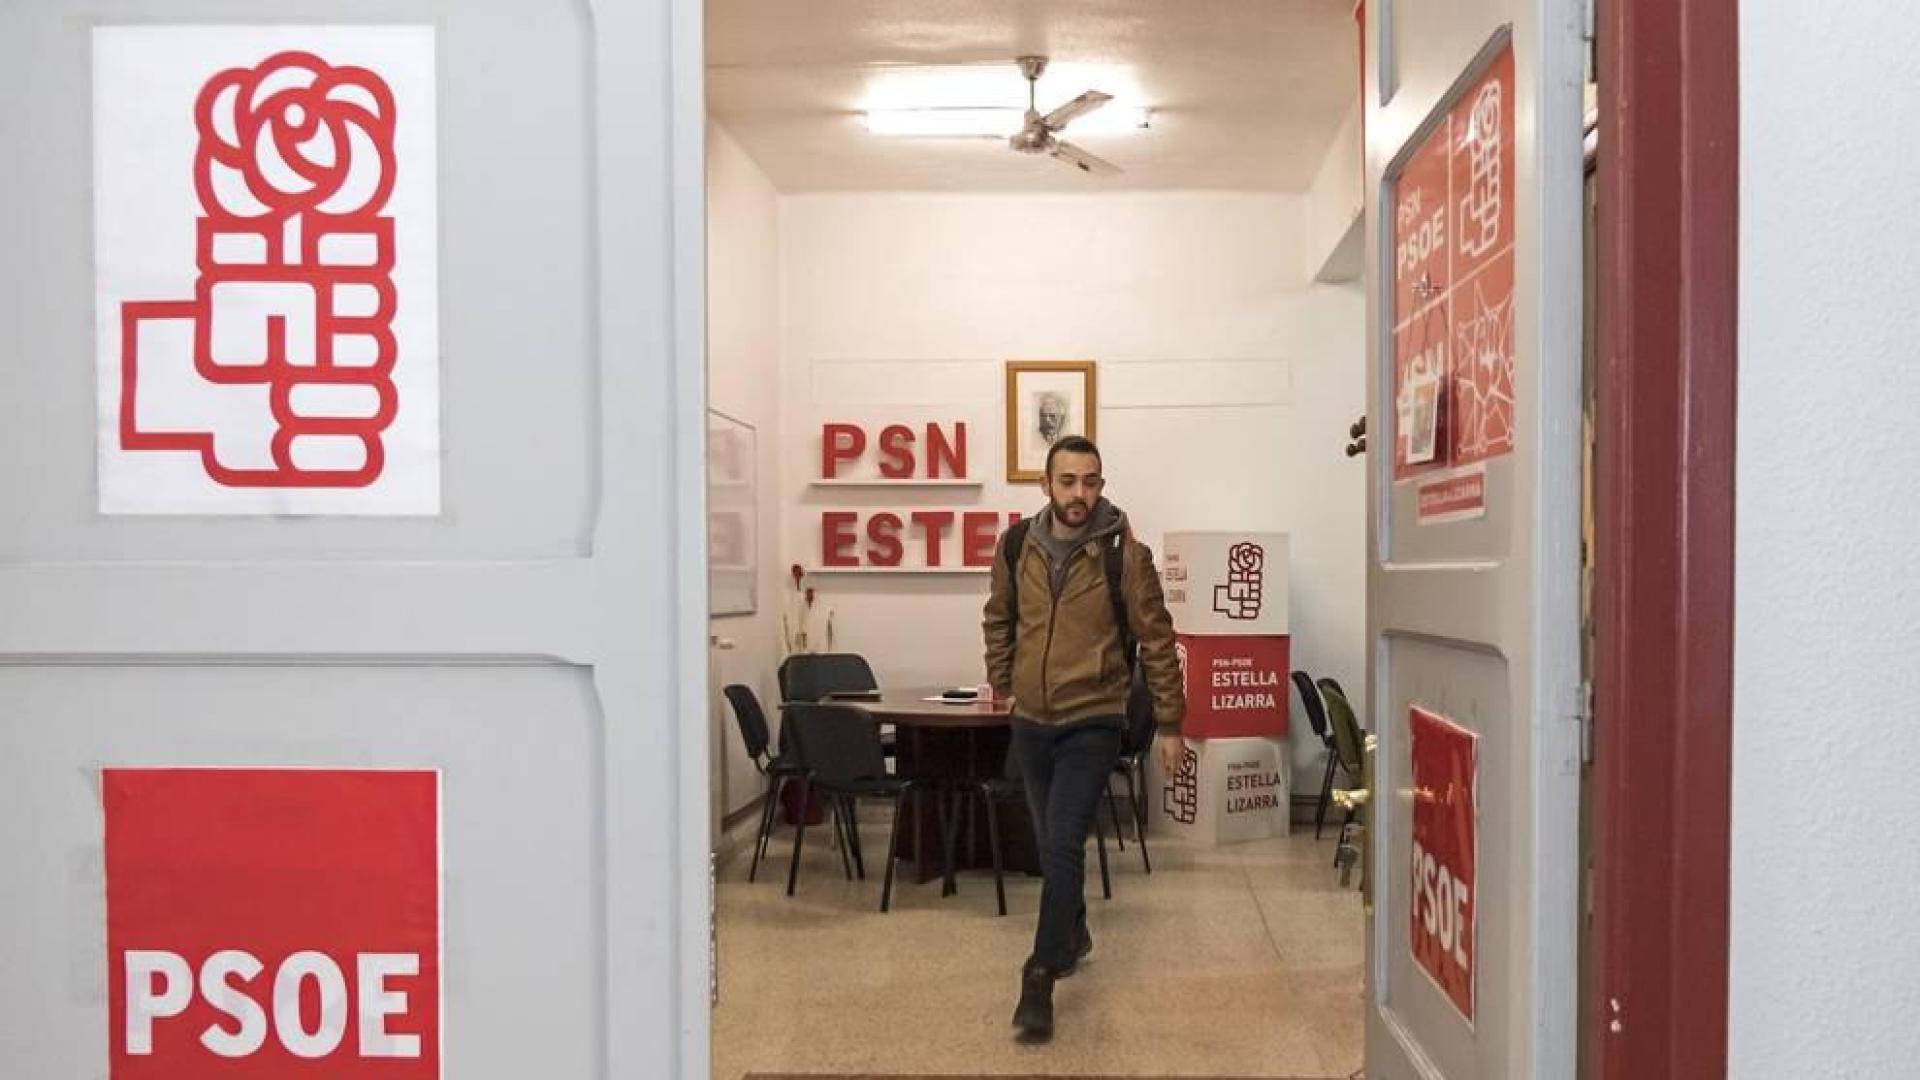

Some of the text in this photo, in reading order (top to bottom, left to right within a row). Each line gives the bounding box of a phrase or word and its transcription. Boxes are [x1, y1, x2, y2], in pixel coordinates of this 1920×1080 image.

[1398, 206, 1444, 281] PSOE
[823, 422, 966, 479] PSN
[822, 511, 1022, 567] ESTE
[1212, 671, 1277, 687] ESTELLA
[1212, 694, 1275, 710] LIZARRA
[1227, 772, 1280, 791] ESTELLA
[1227, 795, 1278, 813] LIZARRA
[1412, 840, 1467, 971] PSOE
[124, 950, 421, 1057] PSOE
